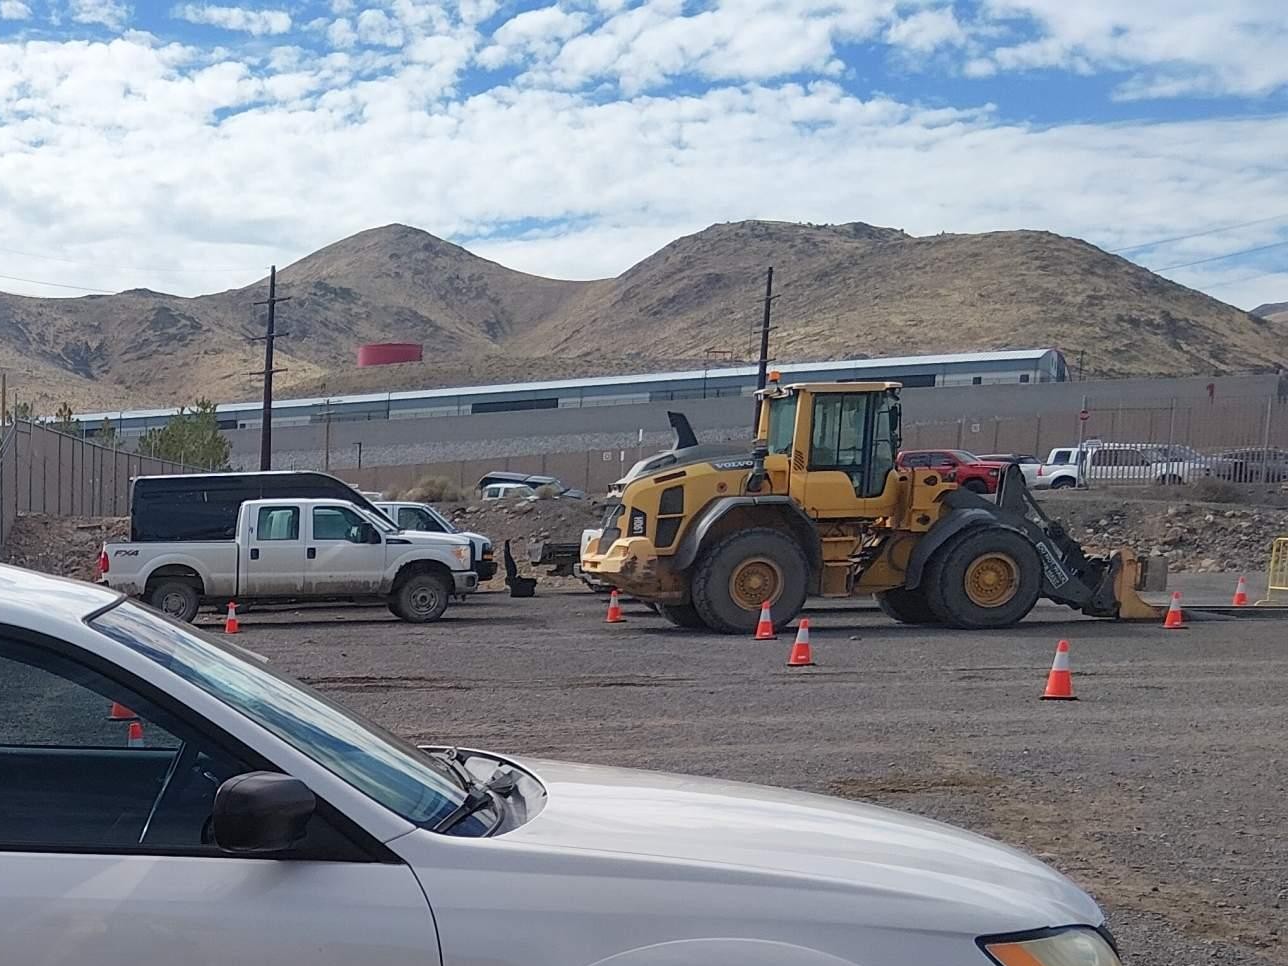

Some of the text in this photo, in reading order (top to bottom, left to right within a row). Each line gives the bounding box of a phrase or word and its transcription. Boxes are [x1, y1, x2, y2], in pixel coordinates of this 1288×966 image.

[714, 460, 753, 468] VOLVO
[632, 516, 644, 534] L90H
[114, 549, 140, 557] FX4
